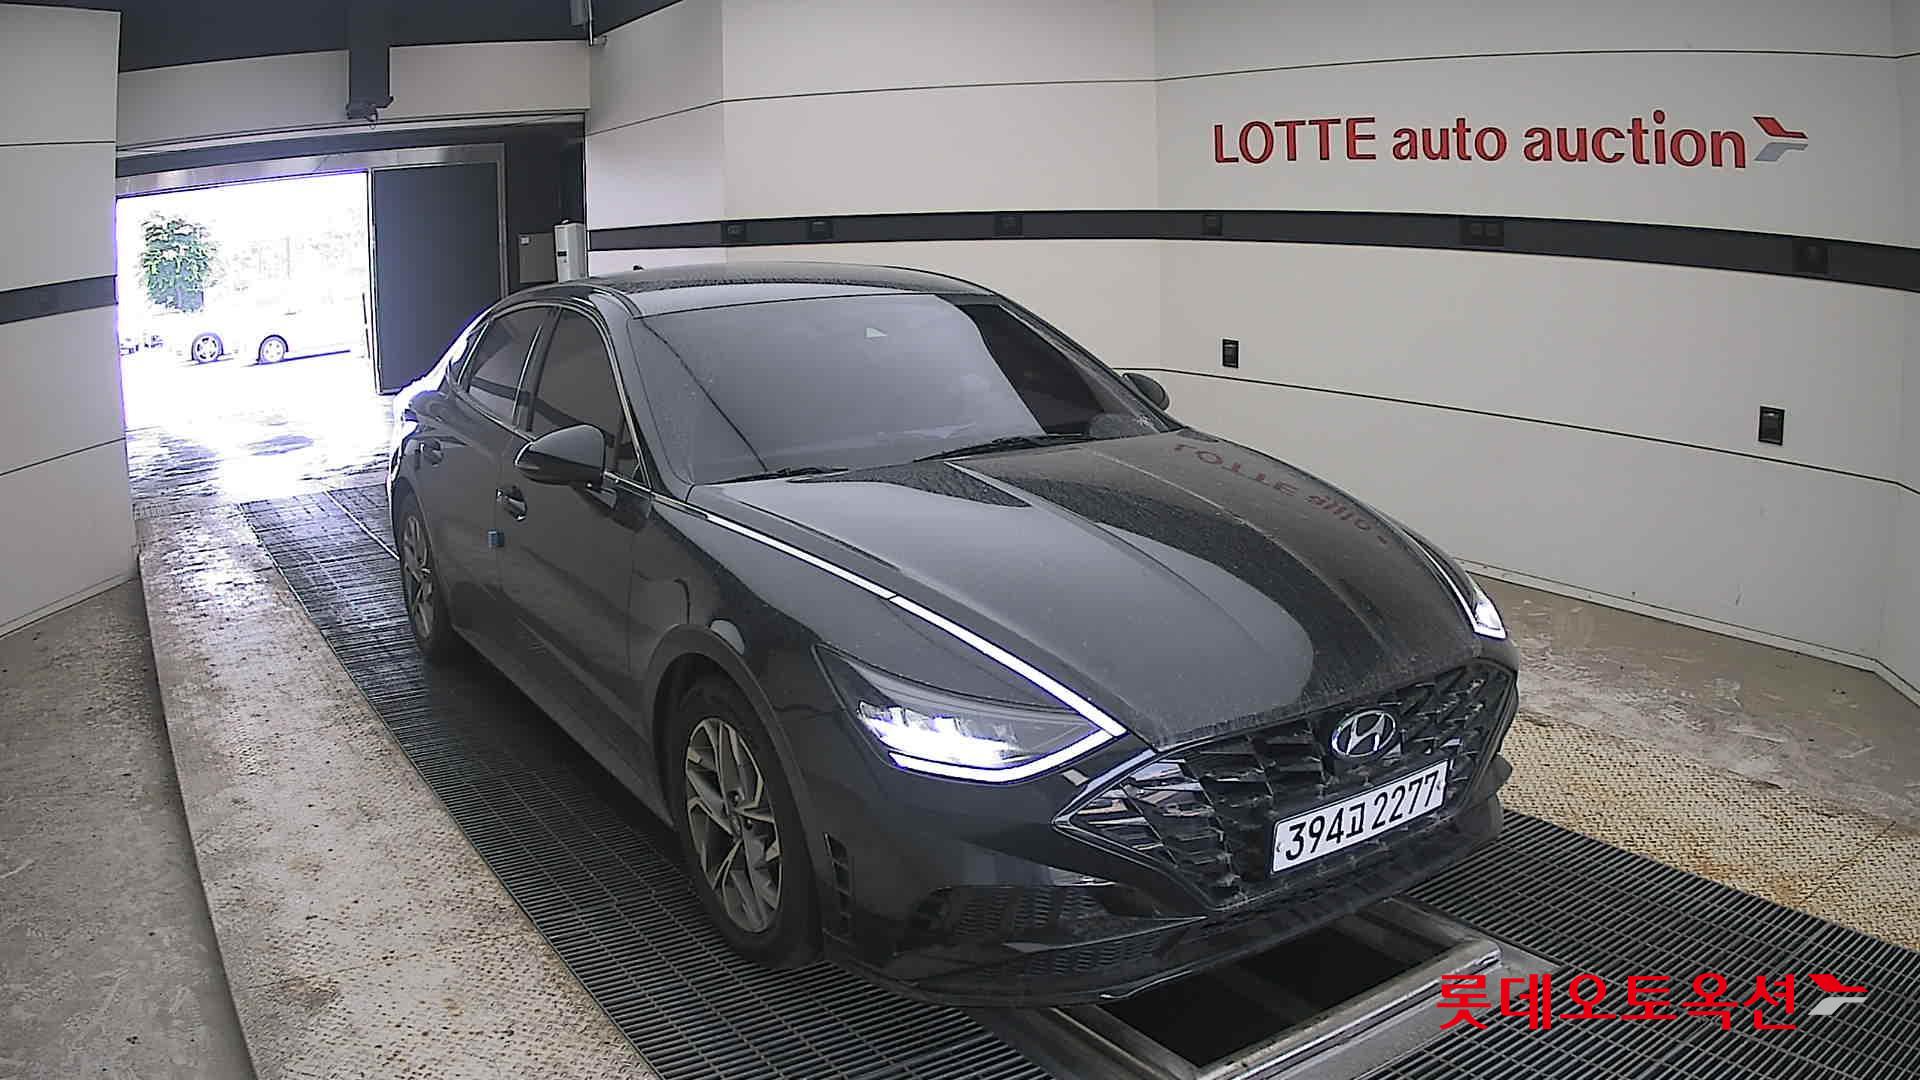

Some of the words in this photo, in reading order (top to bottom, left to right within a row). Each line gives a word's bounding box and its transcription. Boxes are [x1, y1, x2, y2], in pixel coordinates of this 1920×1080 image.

[1214, 117, 1376, 164] LOTTE
[1392, 117, 1508, 161] auto
[1523, 109, 1746, 169] auction
[1285, 802, 1366, 861] 394고
[1371, 771, 1439, 830] 2277
